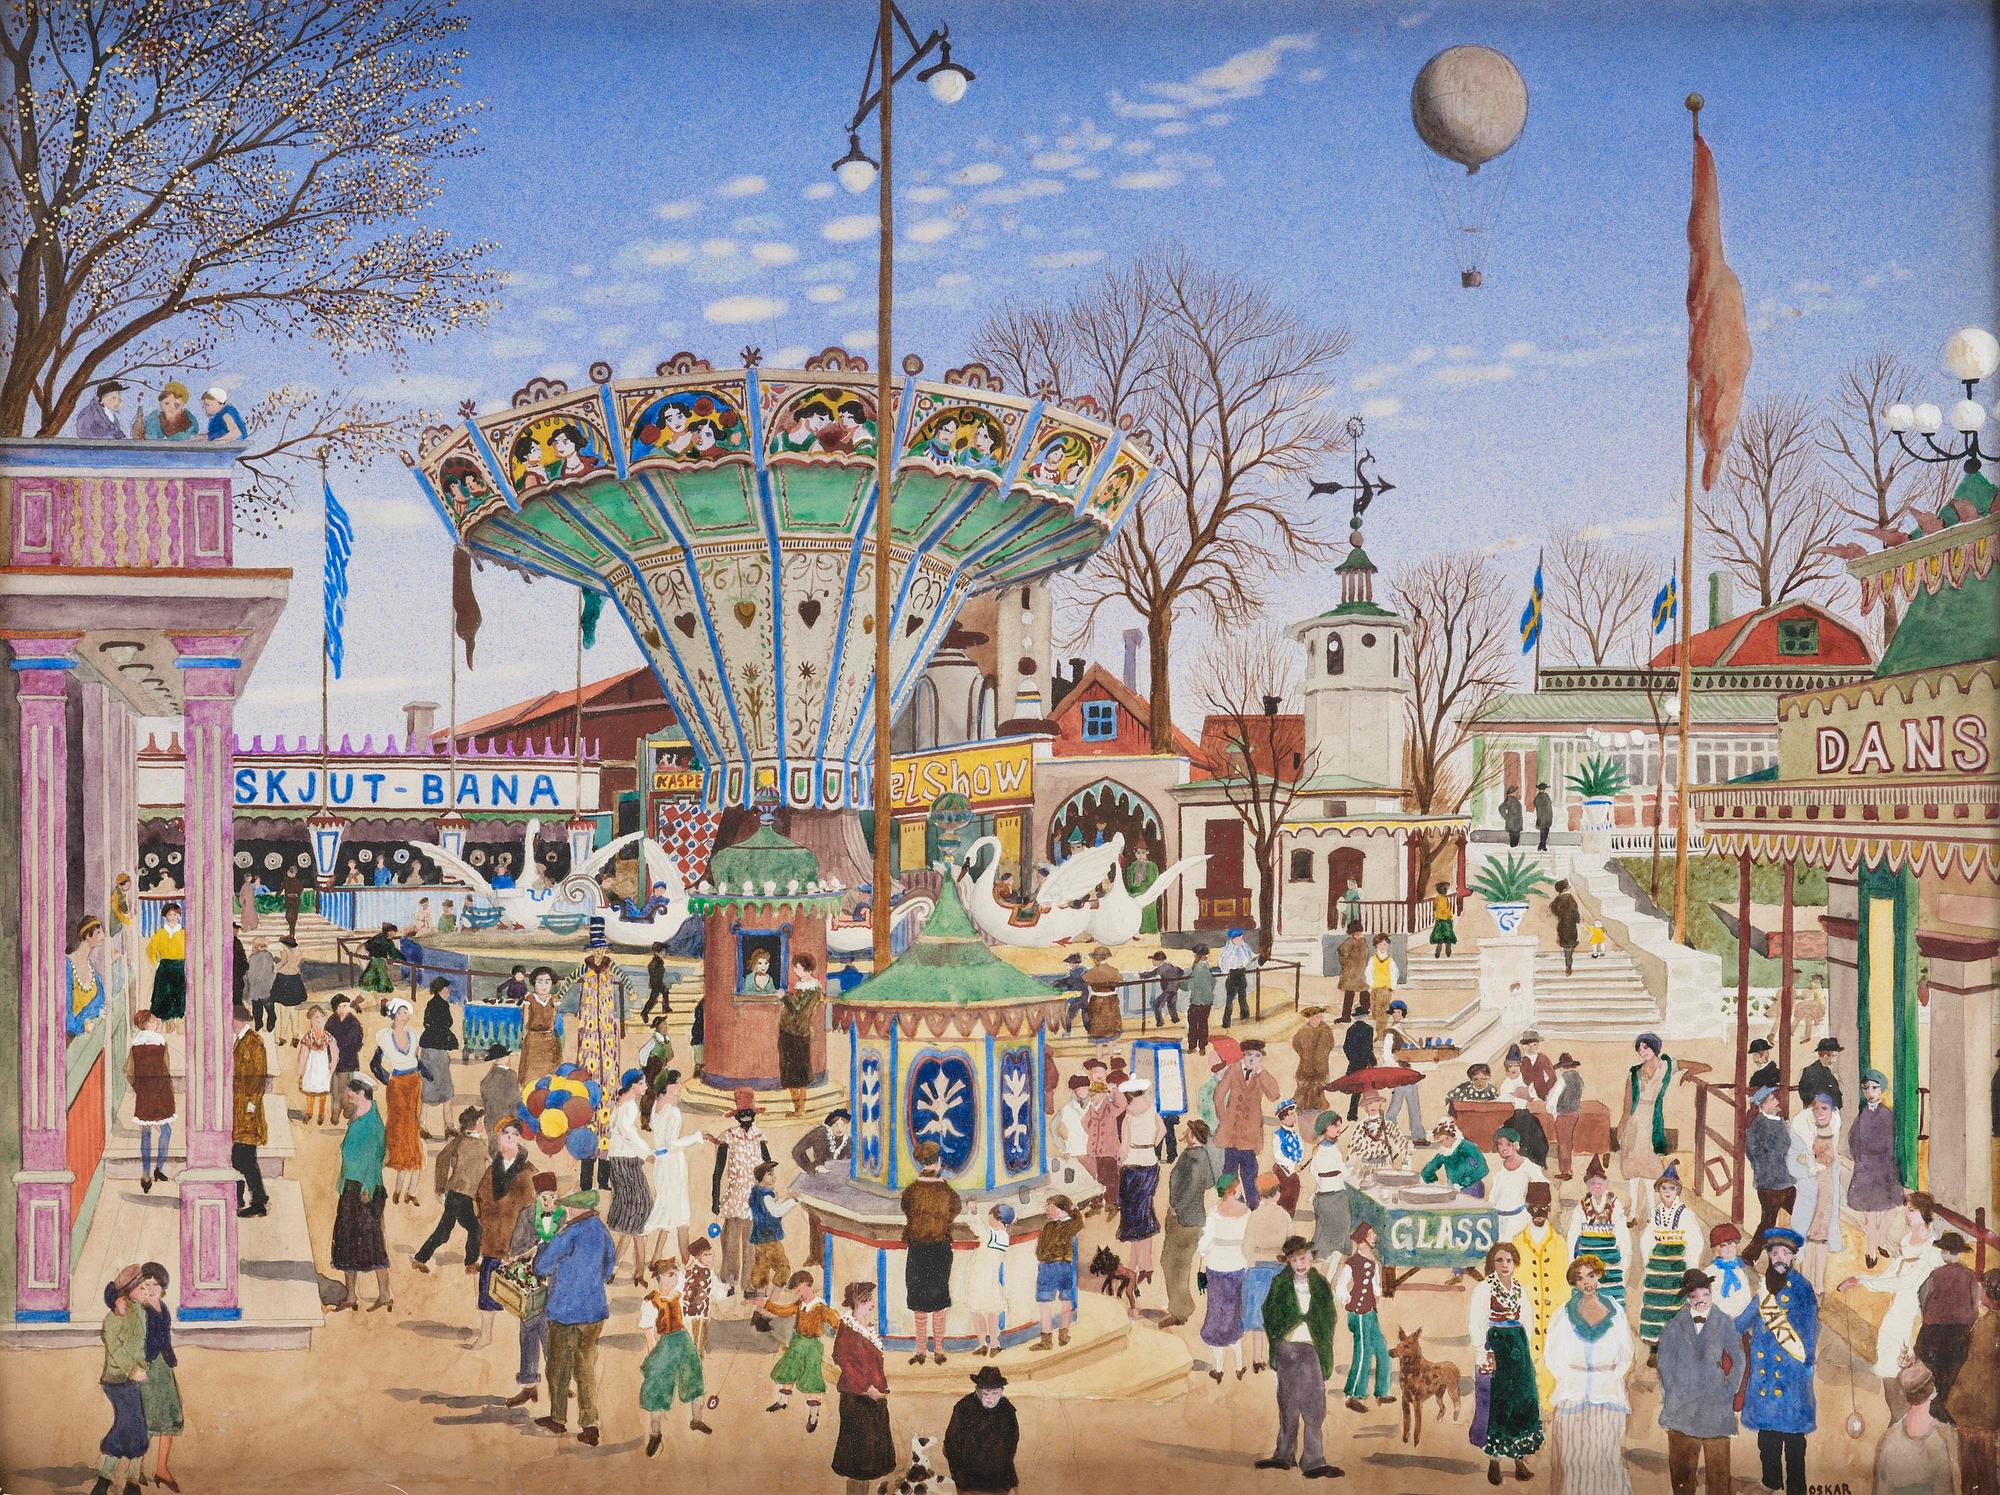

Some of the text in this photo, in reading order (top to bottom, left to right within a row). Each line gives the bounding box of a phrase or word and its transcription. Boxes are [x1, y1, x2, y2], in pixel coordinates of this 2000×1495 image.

[1817, 713, 1991, 775] DANS
[234, 768, 560, 807] SKJUT-BANA
[656, 773, 703, 789] KASPE
[1390, 1215, 1494, 1252] GLASS
[1808, 1483, 1852, 1495] OSKAR
